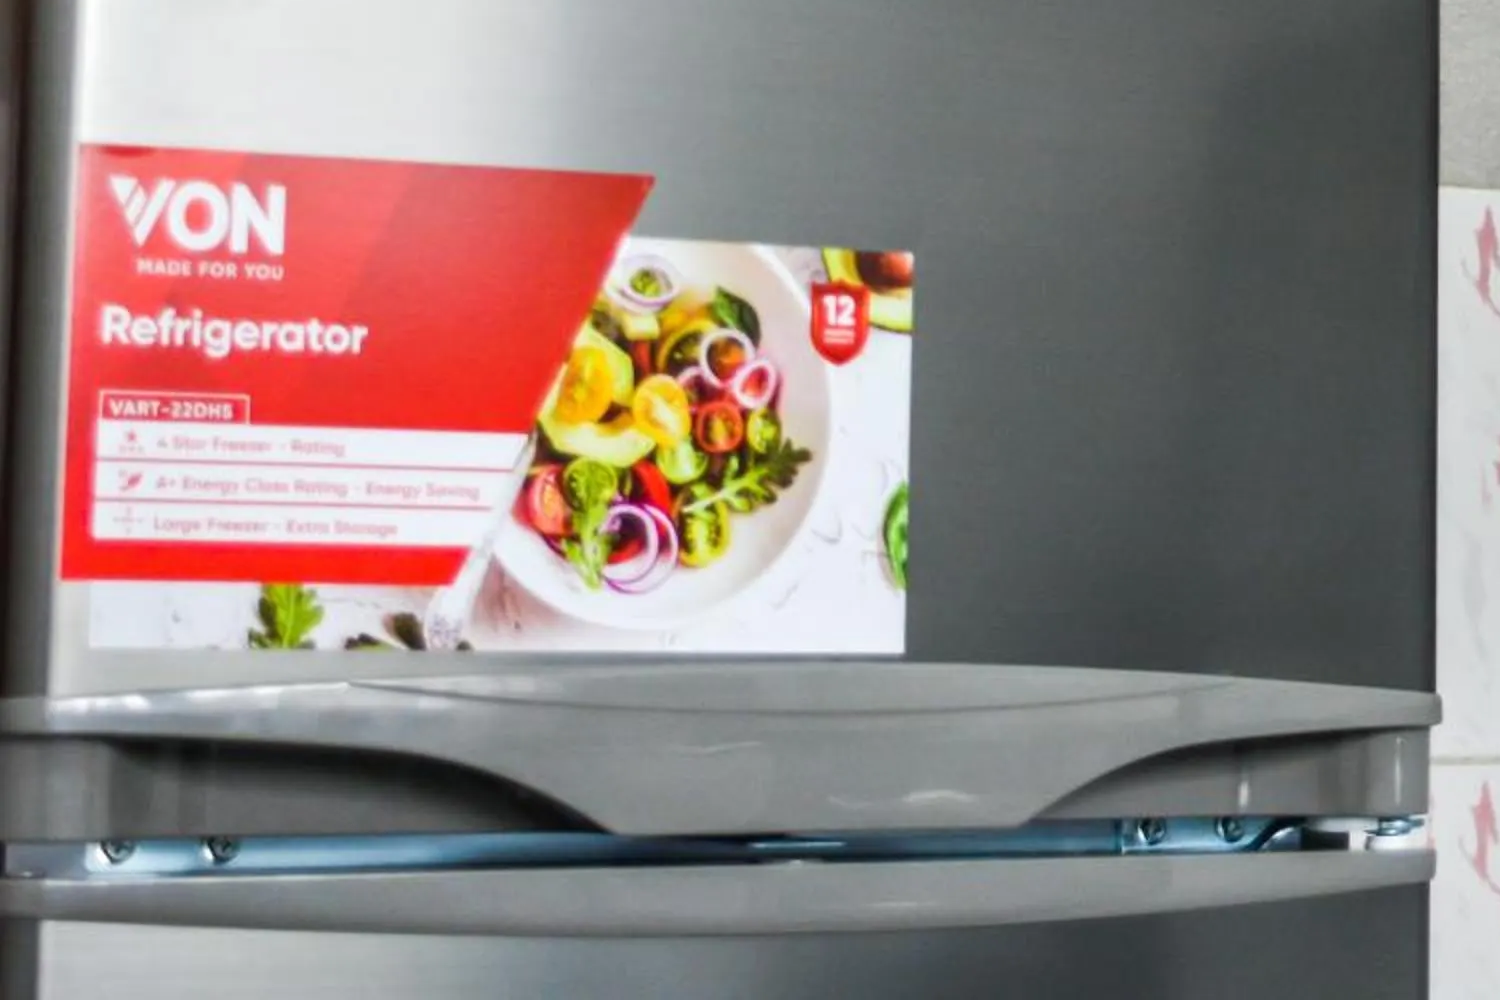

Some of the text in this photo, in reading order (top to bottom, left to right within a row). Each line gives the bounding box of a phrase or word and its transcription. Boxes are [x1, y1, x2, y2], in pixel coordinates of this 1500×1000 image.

[109, 174, 287, 256] VON
[137, 259, 285, 281] MADE FOR YOU
[99, 304, 369, 359] Refrigerator
[824, 295, 856, 326] 12
